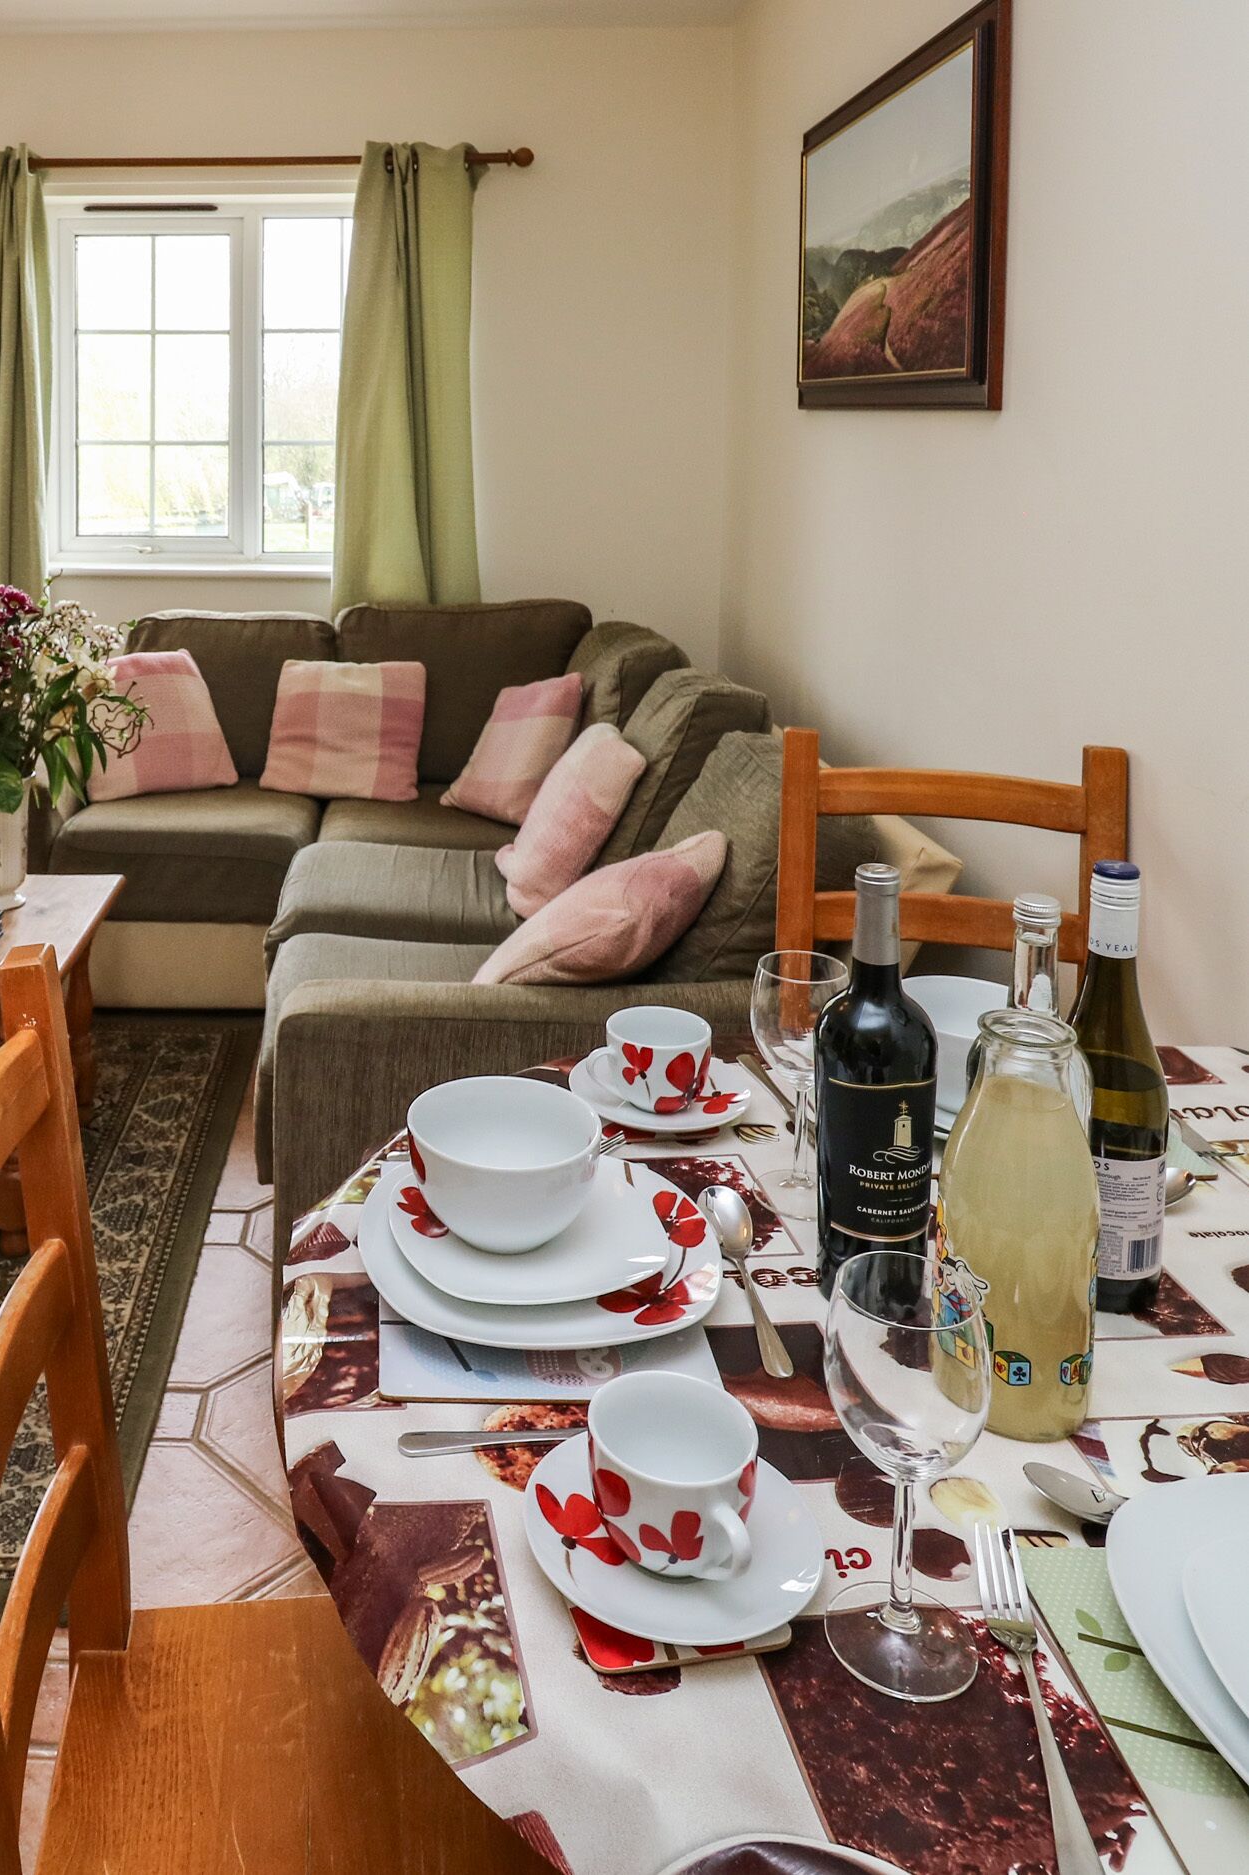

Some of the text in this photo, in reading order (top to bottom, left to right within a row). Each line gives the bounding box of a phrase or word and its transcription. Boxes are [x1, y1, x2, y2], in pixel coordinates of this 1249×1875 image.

[1105, 943, 1138, 953] YEAL
[848, 1164, 895, 1181] ROBERT
[859, 1181, 894, 1191] PRIVATE
[856, 1205, 897, 1216] CABERNET
